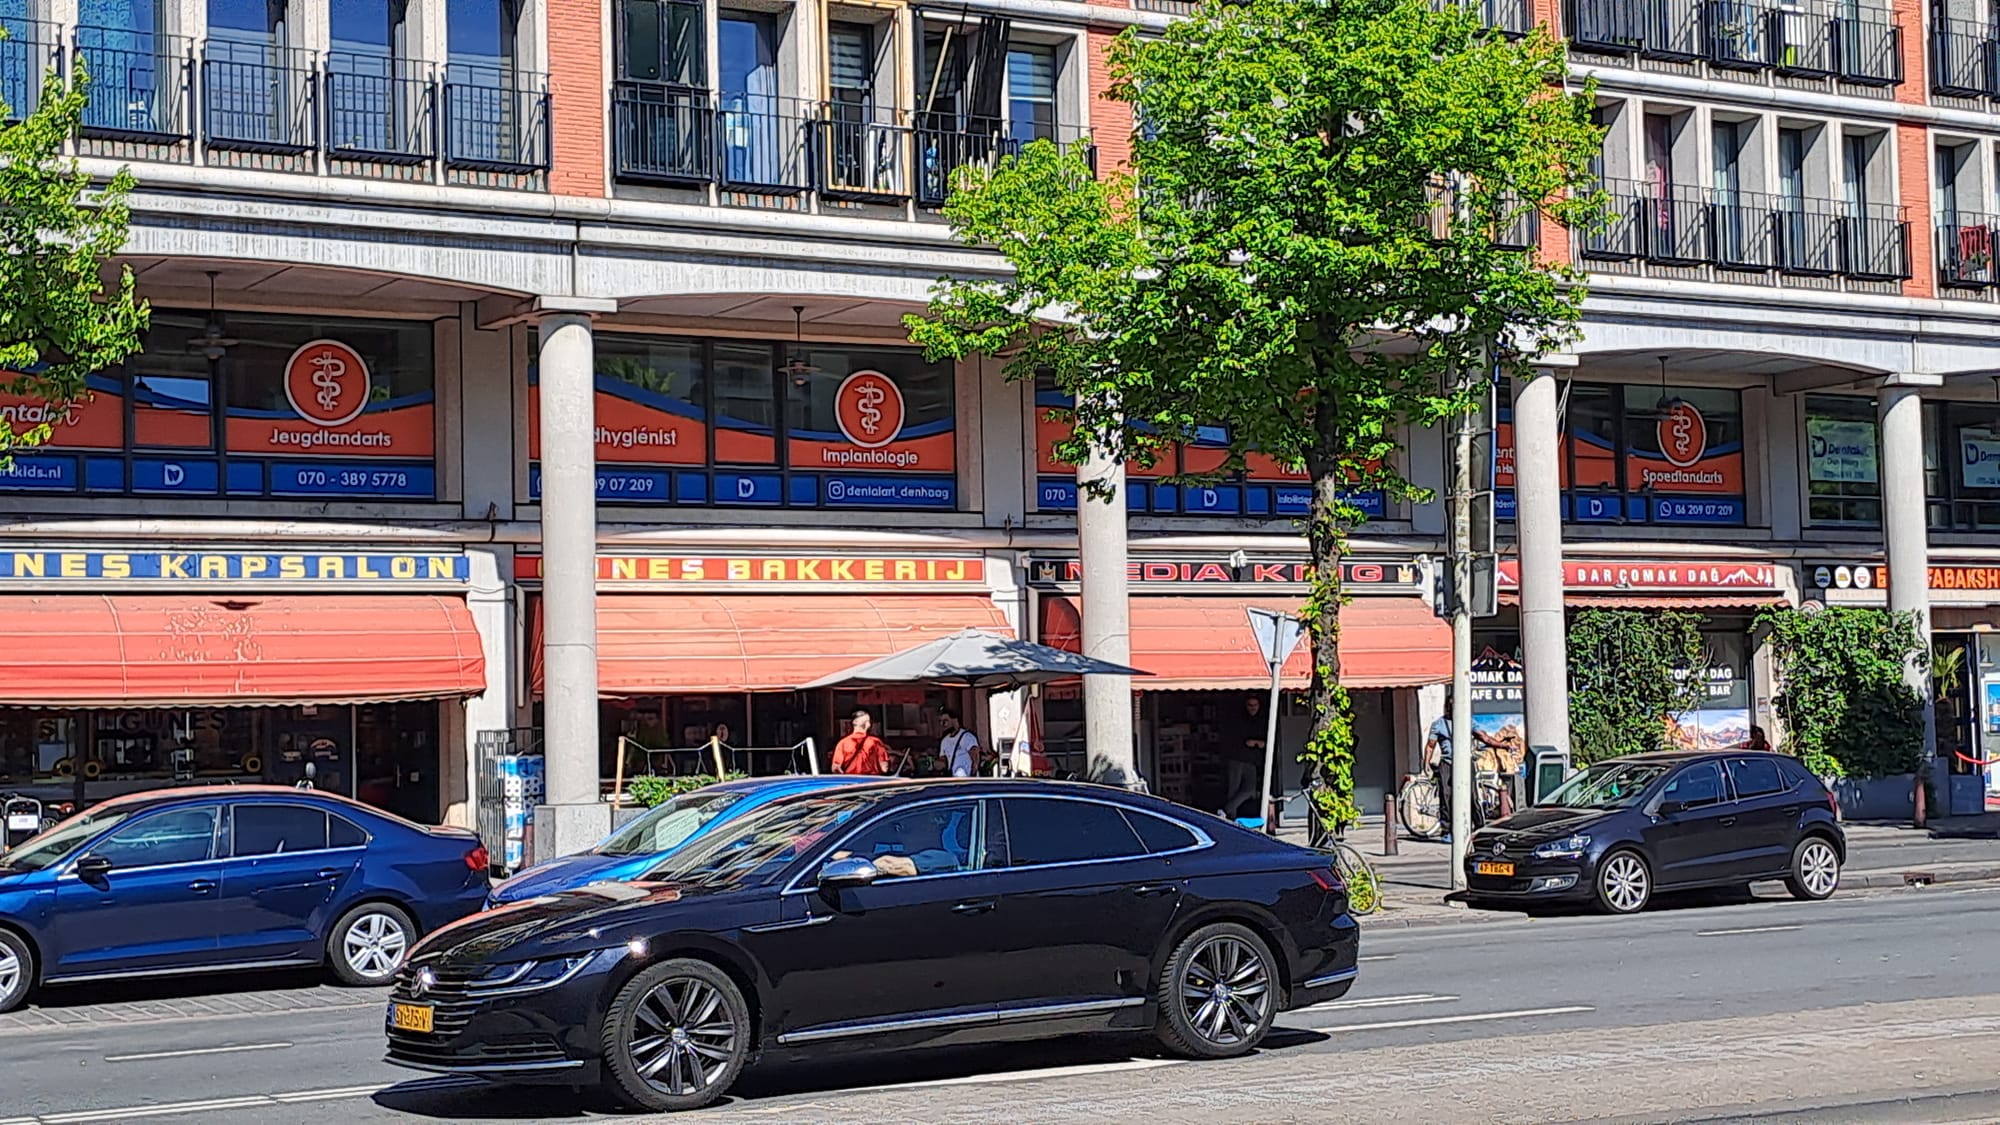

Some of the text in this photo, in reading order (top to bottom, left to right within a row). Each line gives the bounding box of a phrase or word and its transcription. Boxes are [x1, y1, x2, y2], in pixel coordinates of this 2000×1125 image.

[269, 428, 392, 448] Jeugdtandarts
[822, 447, 919, 467] Implantologie
[297, 471, 326, 486] 070
[340, 472, 367, 487] 389
[371, 473, 407, 487] 5778
[609, 478, 627, 491] 07
[629, 479, 653, 492] 209
[1642, 468, 1724, 488] Spoedtandarts
[847, 485, 949, 500] dentalart_denhaag
[1045, 488, 1066, 501] 070
[1675, 503, 1733, 516] 06 209 07 209
[160, 554, 454, 579] KAPSALON
[596, 558, 965, 580] NES BAKKERIJ
[1253, 563, 1384, 583] KIG
[1577, 568, 1613, 583] BAR
[1709, 685, 1731, 696] BAR
